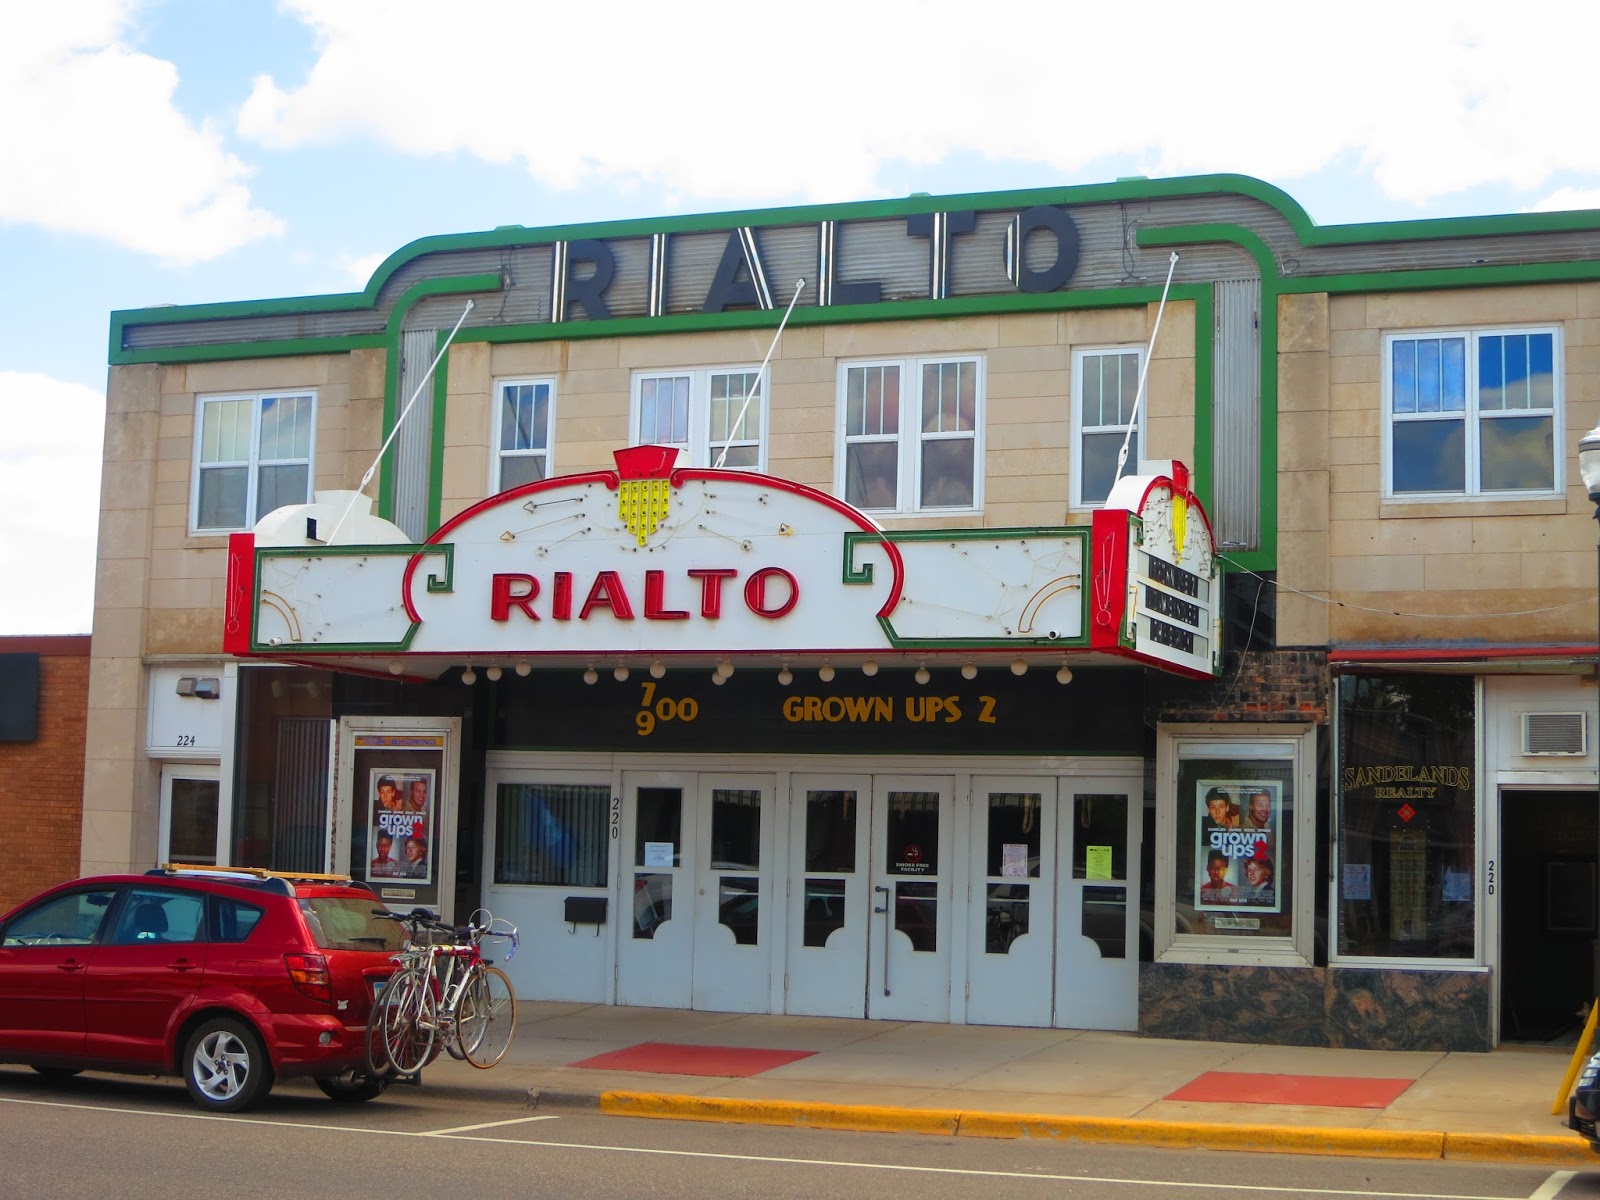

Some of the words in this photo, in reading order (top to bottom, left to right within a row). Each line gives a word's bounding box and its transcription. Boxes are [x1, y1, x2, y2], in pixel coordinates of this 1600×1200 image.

[550, 205, 1080, 323] RIALTO
[491, 566, 800, 621] RIALTO
[782, 696, 893, 722] GROWN
[905, 696, 962, 723] UPS
[978, 696, 997, 724] 2
[177, 735, 196, 747] 224
[391, 738, 436, 746] SHOWING
[1344, 765, 1470, 792] SANDELANDS
[1375, 787, 1437, 799] REALTY
[379, 813, 423, 829] grown
[611, 797, 620, 839] 220
[387, 824, 413, 839] ups
[412, 822, 423, 838] 2
[1210, 832, 1268, 849] grown
[1222, 843, 1254, 860] ups
[1254, 840, 1268, 860] 2
